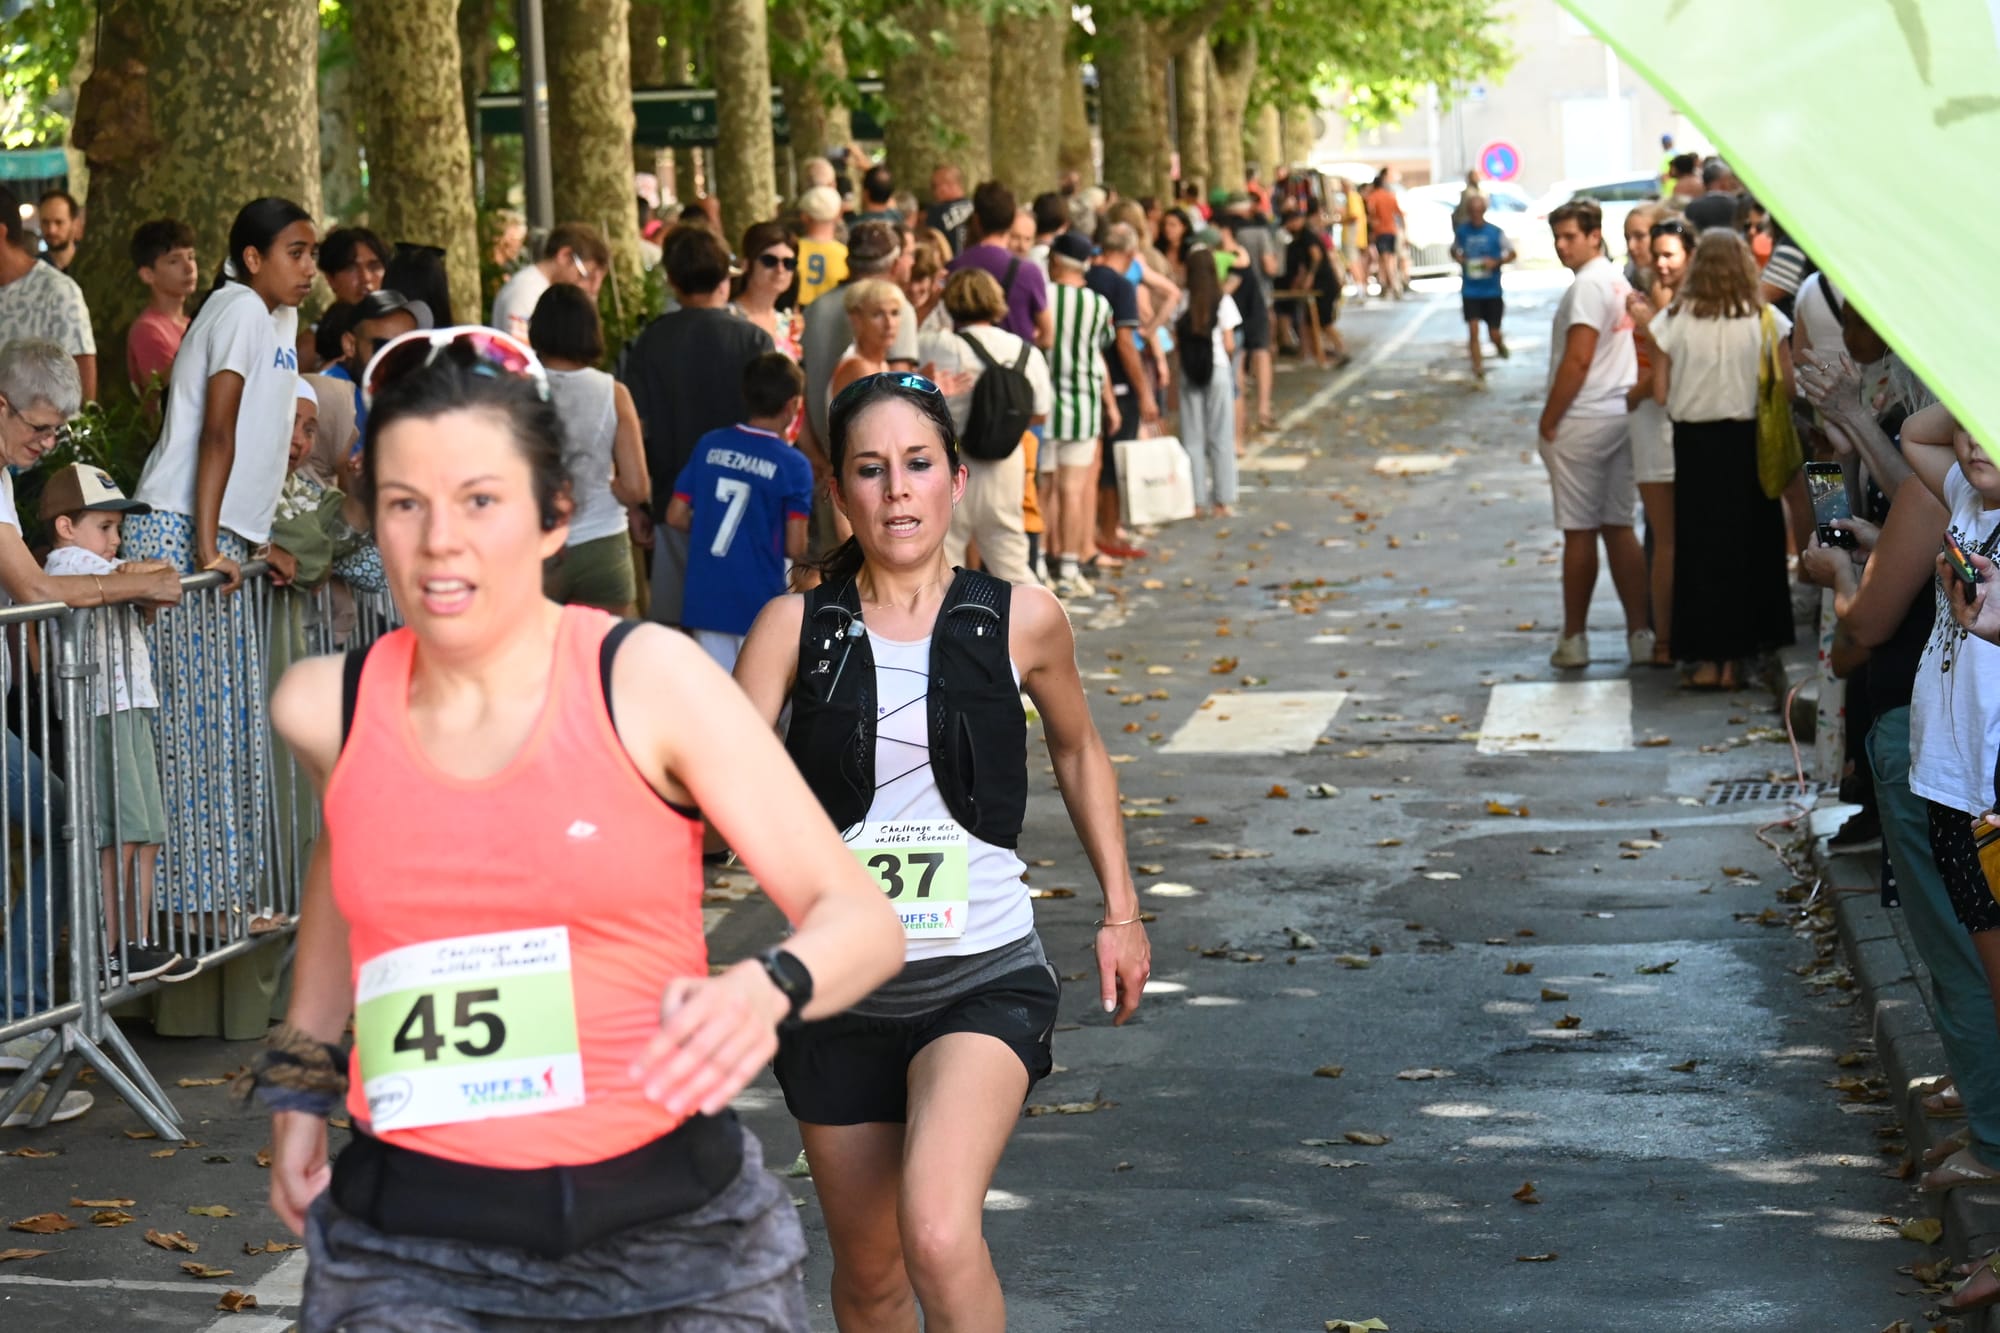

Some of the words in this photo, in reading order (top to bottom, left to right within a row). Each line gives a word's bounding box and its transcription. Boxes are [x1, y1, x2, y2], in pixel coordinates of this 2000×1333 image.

[806, 253, 825, 285] 9
[710, 477, 751, 557] 7
[874, 834, 911, 844] vallées
[916, 832, 960, 843] cévenoles
[880, 824, 931, 835] Challenge
[937, 823, 955, 832] des
[867, 853, 945, 899] 37
[898, 912, 939, 924] UFF'S
[903, 921, 944, 930] venture
[393, 987, 506, 1062] 45
[461, 1076, 534, 1096] TUFF'S
